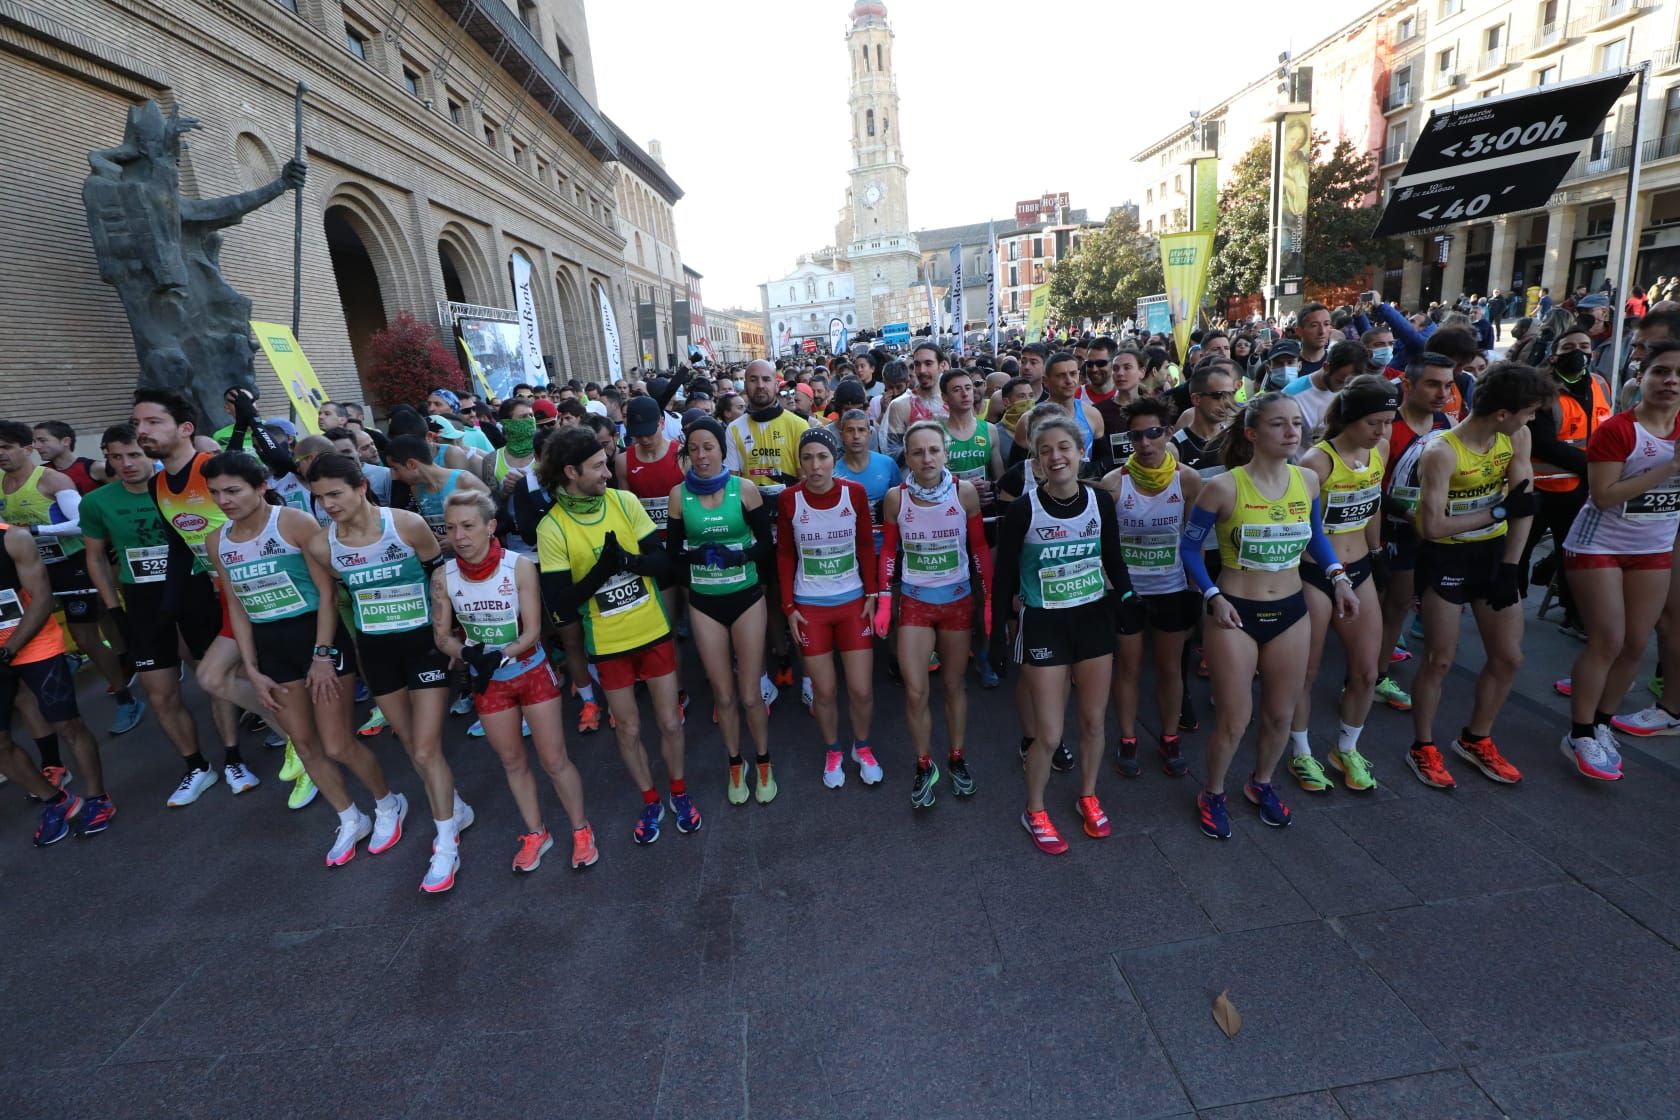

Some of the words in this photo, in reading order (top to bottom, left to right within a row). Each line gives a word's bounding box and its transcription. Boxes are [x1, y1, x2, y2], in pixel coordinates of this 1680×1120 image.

[1458, 114, 1496, 126] ZARAGOZA
[1440, 114, 1567, 158] <3:00h
[519, 280, 541, 370] CaixaBank
[752, 447, 782, 457] CORRE
[1340, 502, 1373, 518] 5259
[1151, 516, 1178, 527] ZUERA
[827, 528, 853, 539] ZUERA
[931, 527, 961, 539] ZUERA
[1039, 542, 1097, 560] ATLEET
[1124, 548, 1172, 560] SANDRA
[818, 559, 841, 569] NAT
[916, 555, 947, 565] ARAN
[230, 561, 277, 581] ATLEET
[348, 564, 403, 585] ATLEET
[605, 581, 640, 603] 3005
[1048, 575, 1099, 594] LORENA
[242, 587, 296, 606] ADRIELLE
[363, 600, 424, 615] ADRIENNE
[473, 626, 504, 637] OGA
